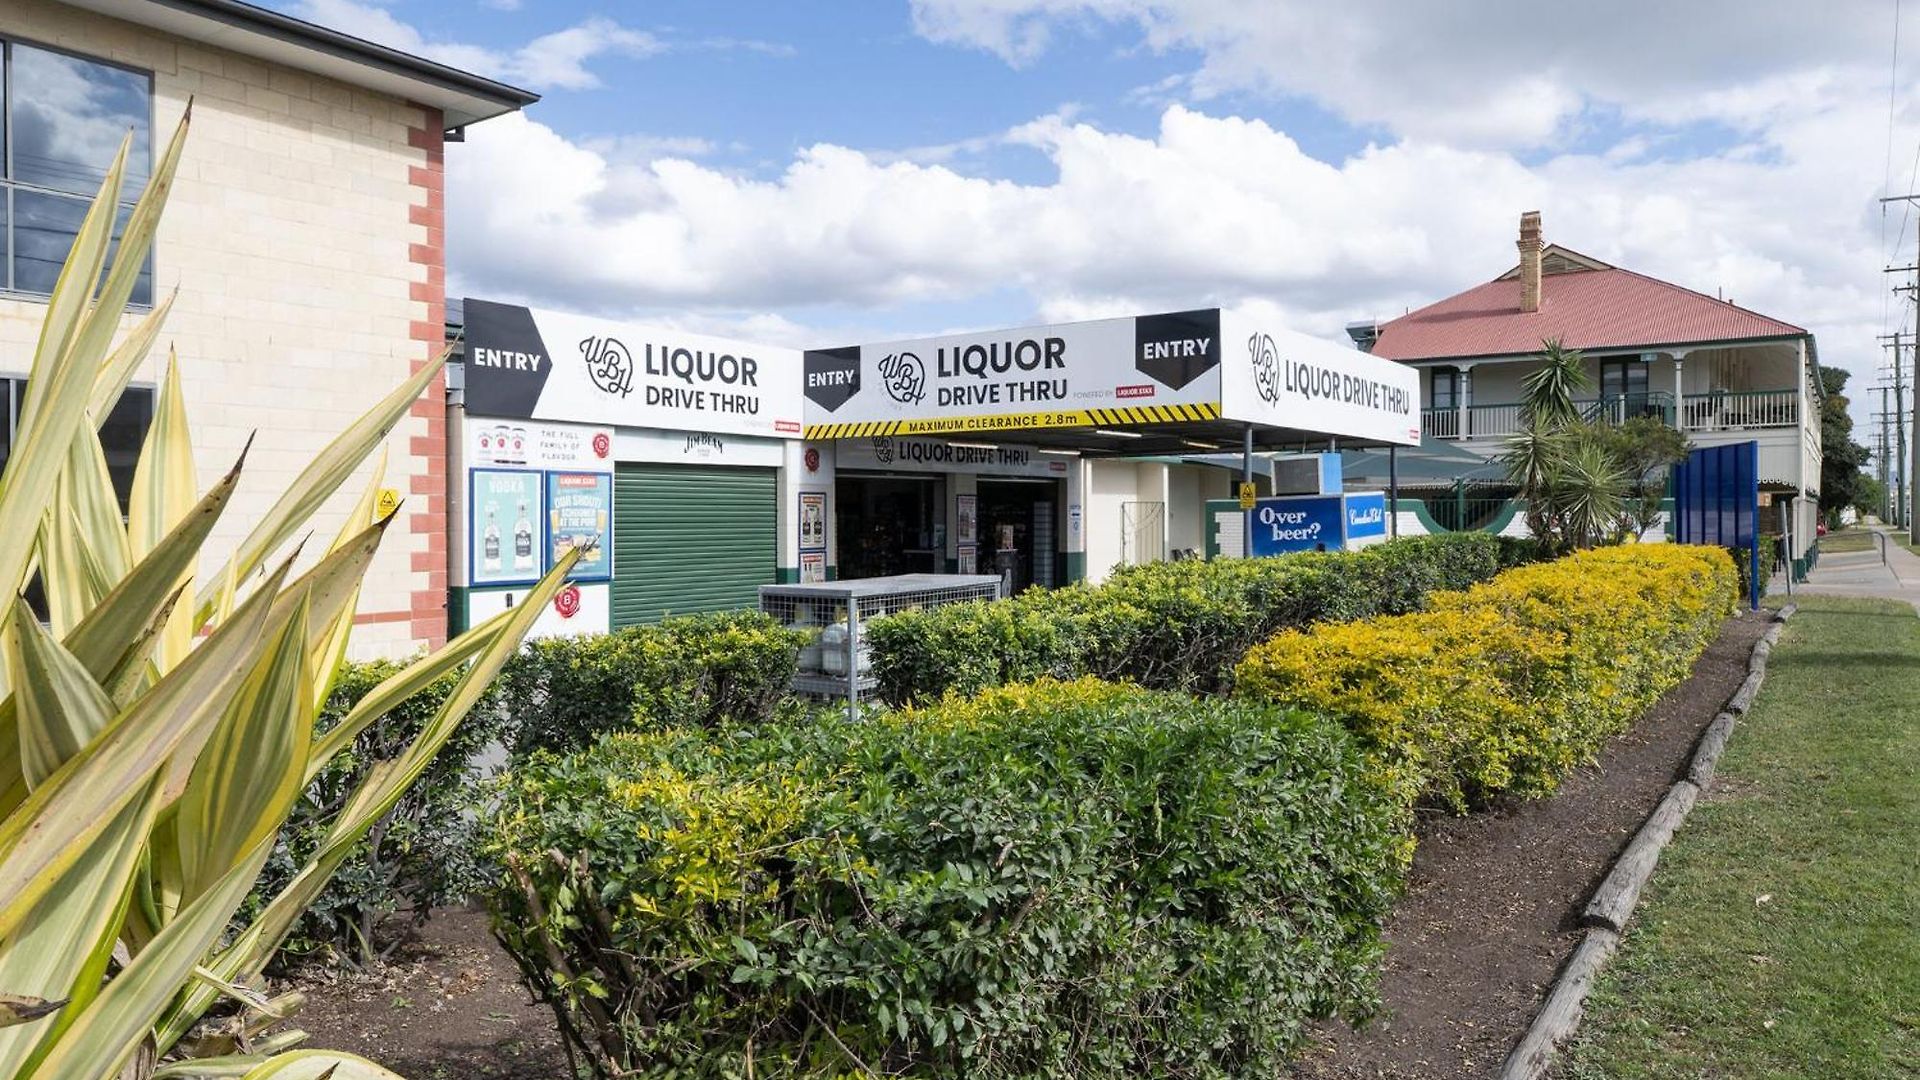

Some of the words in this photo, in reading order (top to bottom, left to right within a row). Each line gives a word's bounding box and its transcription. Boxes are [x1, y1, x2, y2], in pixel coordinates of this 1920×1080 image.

[474, 347, 542, 372] ENTRY
[938, 337, 1067, 379] LIQUOR
[1143, 337, 1211, 360] ENTRY
[645, 343, 758, 387] LIQUOR
[808, 369, 855, 387] ENTRY
[1285, 359, 1340, 401] LIQUOR
[1343, 374, 1379, 409] DRIVE
[1381, 384, 1409, 415] THRU
[646, 385, 705, 411] DRIVE
[709, 392, 760, 415] THRU
[938, 384, 999, 407] DRIVE
[1005, 379, 1068, 402] THRU
[1117, 388, 1138, 396] LIQUOR
[908, 418, 964, 433] MAXIMUM
[968, 415, 1038, 430] CLEARANCE
[1045, 413, 1078, 426] 2.8m
[684, 435, 700, 453] JIM
[701, 431, 723, 453] BEAM
[899, 441, 953, 464] LIQUOR
[956, 446, 994, 465] DRIVE
[996, 447, 1029, 466] THRU
[489, 479, 525, 493] VODKA
[1259, 507, 1307, 524] Over
[1272, 522, 1321, 541] beer?
